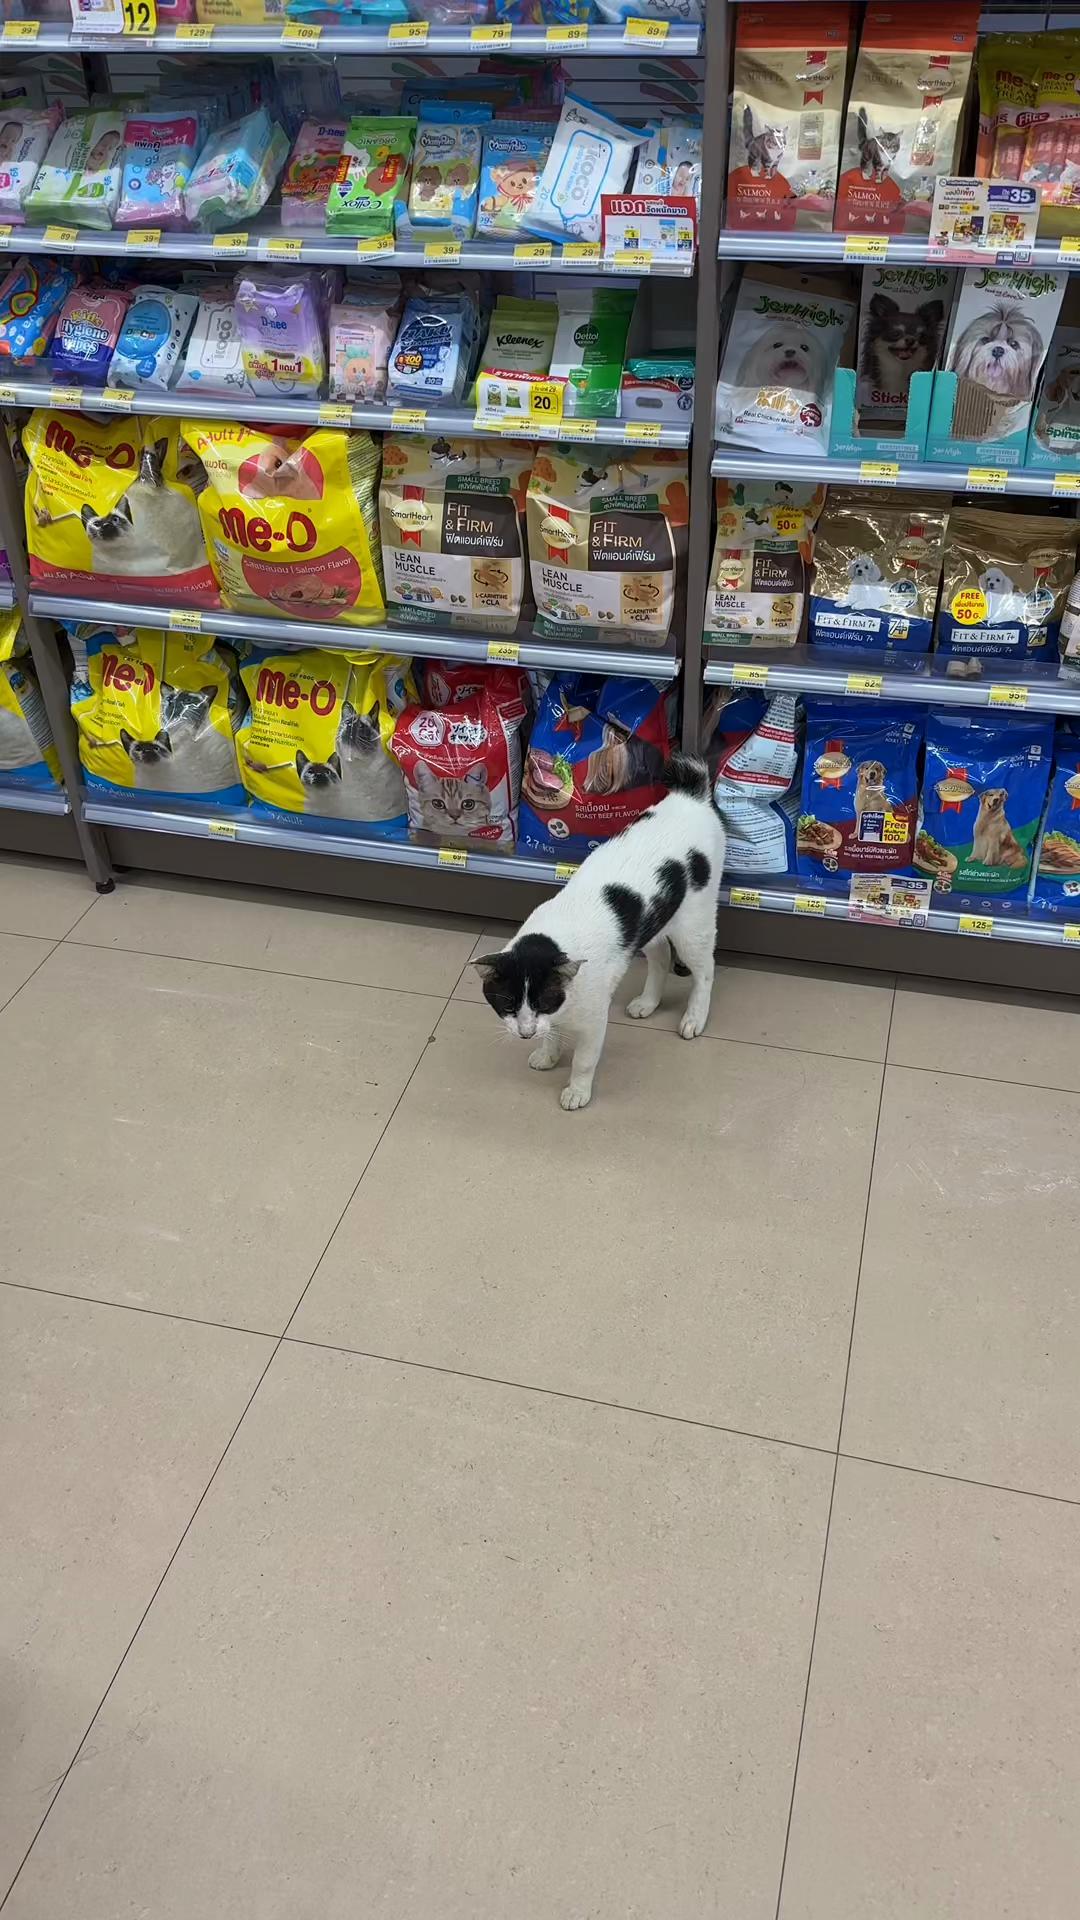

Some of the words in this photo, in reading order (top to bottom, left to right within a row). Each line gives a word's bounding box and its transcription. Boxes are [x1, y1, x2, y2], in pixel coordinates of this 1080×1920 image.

[125, 3, 150, 32] 12
[189, 29, 206, 37] 129
[297, 29, 314, 38] 109
[409, 28, 421, 36] 95
[492, 30, 504, 38] 79
[568, 30, 580, 38] 89
[647, 26, 660, 36] 89
[736, 186, 772, 197] SALMON
[848, 189, 882, 201] SALMON
[1010, 188, 1031, 202] 35
[342, 198, 382, 210] Cellox
[611, 200, 646, 214] แจก
[60, 232, 71, 240] 89
[143, 234, 154, 242] 39
[231, 238, 242, 247] 39
[377, 240, 388, 248] 39
[442, 246, 455, 255] 39
[533, 248, 546, 257] 29
[973, 266, 1057, 298] JerHigh
[754, 296, 845, 328] JerHigh
[260, 316, 288, 330] D-nee
[62, 318, 110, 343] Hygiene
[496, 334, 545, 349] Kleenex
[574, 332, 599, 341] Dettol
[534, 396, 551, 410] 20
[744, 410, 756, 418] Real
[756, 412, 780, 422] Chicken
[602, 496, 624, 504] SMALL
[625, 495, 648, 503] BREED
[390, 510, 433, 521] SmartHeart
[447, 502, 471, 518] FIT
[445, 520, 454, 530] &
[456, 518, 494, 534] FIRM
[593, 520, 618, 534] FIT
[776, 520, 790, 530] 50
[445, 532, 504, 548] ฟิตแอนด์เฟิร์ม
[592, 536, 602, 547] &
[603, 534, 643, 548] FIRM
[394, 552, 421, 564] LEAN
[592, 549, 656, 562] ฟิตแอนด์เฟิร์ม
[296, 563, 326, 575] Salmon
[327, 557, 352, 570] Flavor
[395, 562, 436, 576] MUSCLE
[755, 559, 772, 568] FIT
[542, 568, 568, 581] LEAN
[762, 568, 788, 578] FIRM
[543, 577, 583, 593] MUSCLE
[960, 592, 980, 600] FREE
[956, 610, 972, 619] 50
[816, 613, 832, 624] FIT
[833, 617, 842, 626] &
[842, 616, 866, 628] FIRM
[868, 620, 876, 628] 7+
[866, 634, 874, 642] 7+
[952, 630, 968, 640] FIT
[970, 632, 978, 641] &
[980, 631, 1004, 641] FIRM
[1006, 632, 1015, 640] 7+
[576, 812, 597, 820] ROAST
[598, 812, 614, 820] BEEF
[884, 820, 907, 829] Free
[526, 835, 540, 850] 2.7
[884, 834, 900, 842] 100
[908, 881, 923, 889] 35
[972, 921, 987, 929] 125
